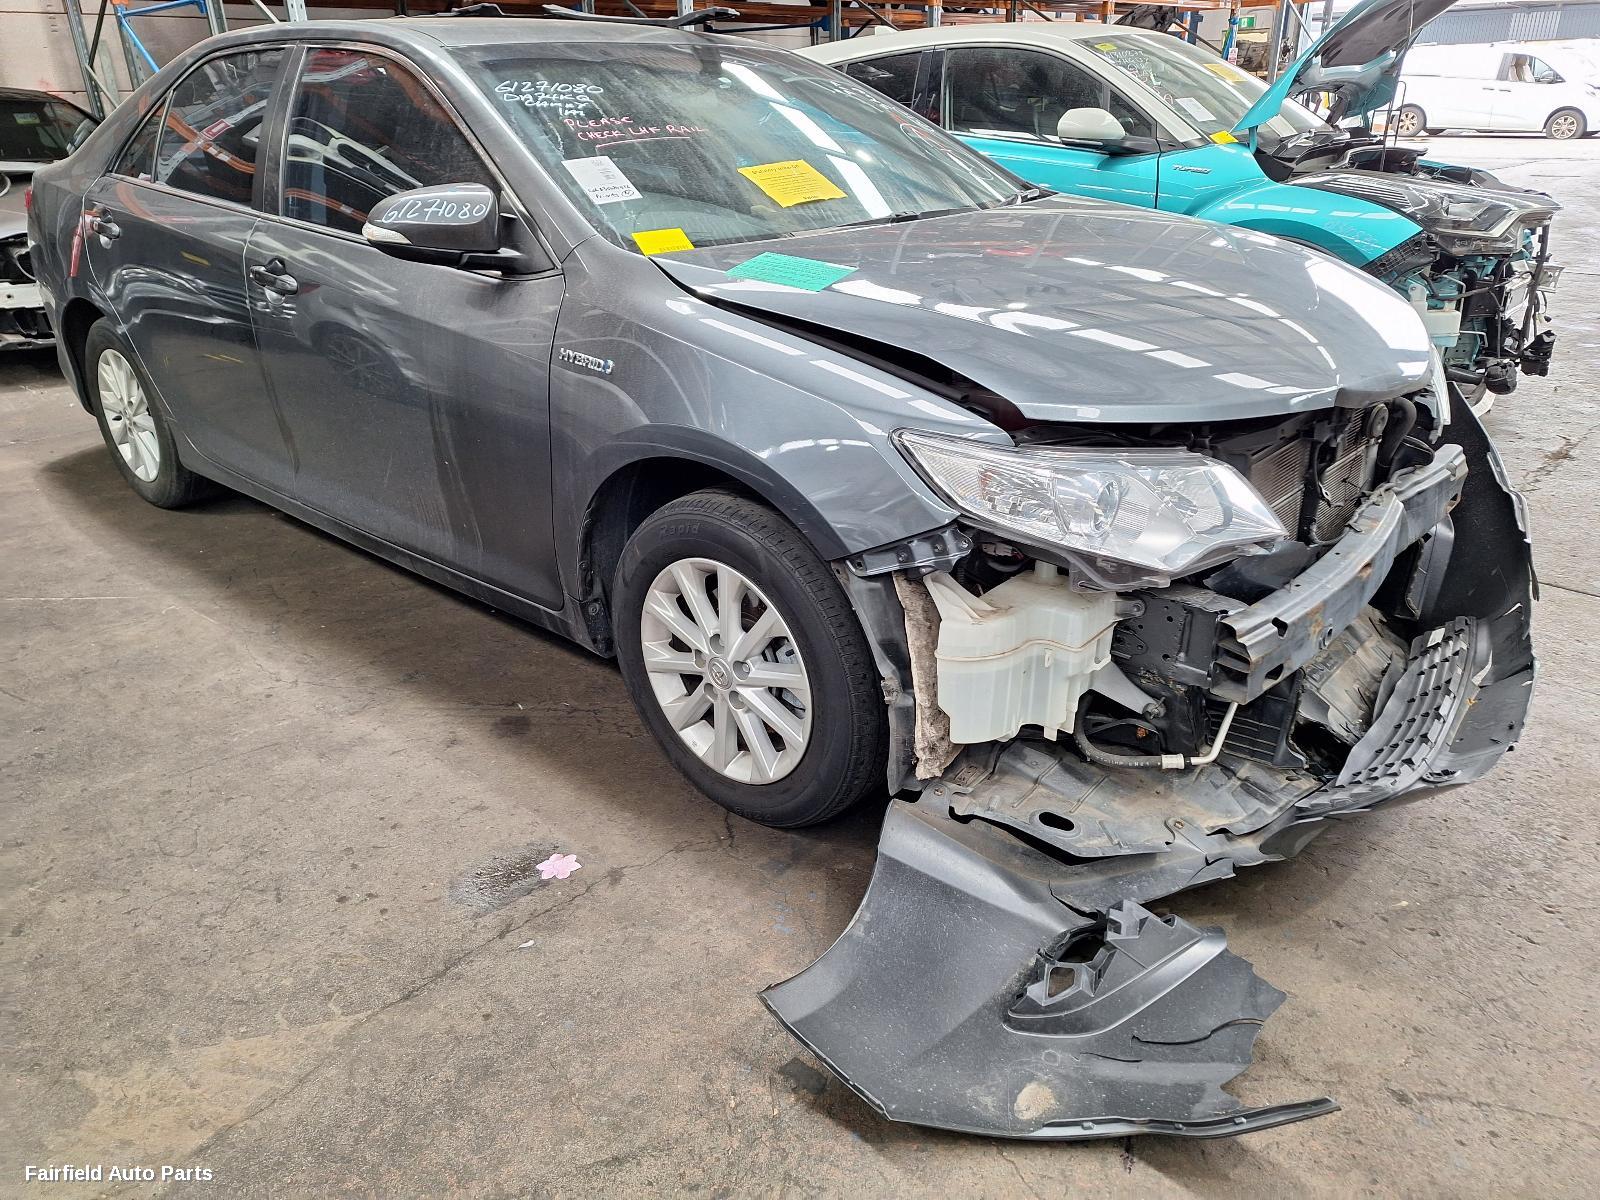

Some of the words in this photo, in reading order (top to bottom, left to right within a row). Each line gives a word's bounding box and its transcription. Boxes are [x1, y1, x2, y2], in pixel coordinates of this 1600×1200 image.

[495, 80, 604, 93] 61271080
[563, 116, 634, 131] PLEASE
[577, 130, 626, 141] CHECK
[628, 125, 661, 136] LHF
[666, 124, 705, 135] RAIL
[382, 199, 486, 223] 61271080
[559, 348, 605, 372] HYBRID
